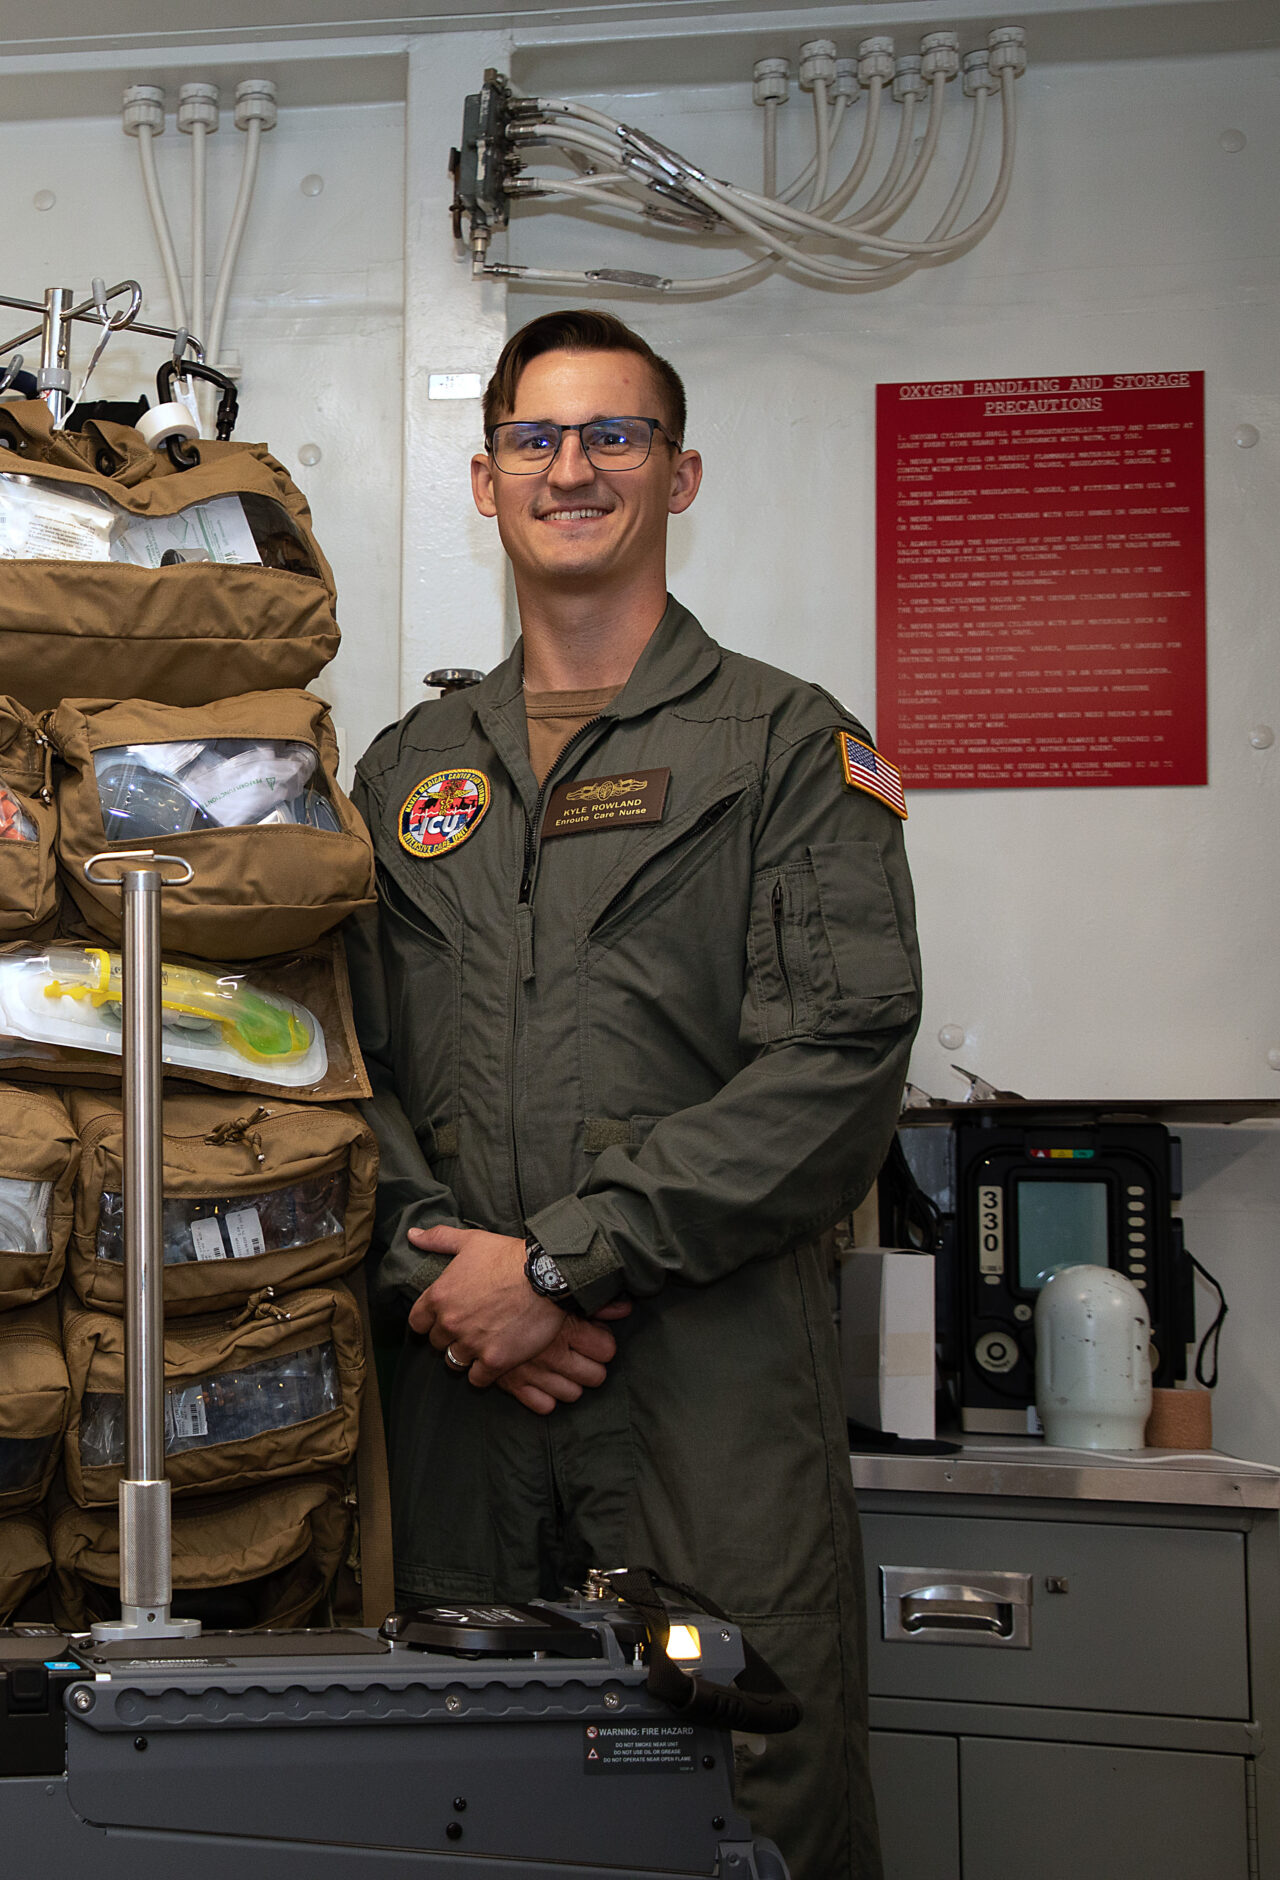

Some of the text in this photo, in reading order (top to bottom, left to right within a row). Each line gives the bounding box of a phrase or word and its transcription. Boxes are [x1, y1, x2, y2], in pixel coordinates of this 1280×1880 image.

[899, 373, 1190, 398] OXYGEN HANDLING AND STORAGE
[985, 397, 1102, 414] PRECAUTIONS
[405, 794, 420, 813] NAVAL
[419, 775, 446, 794] MEDICAL
[555, 807, 647, 826] Enroute Care Nurse
[563, 798, 642, 816] KYLE ROWLAND
[419, 814, 460, 835] ICU
[403, 826, 468, 852] INTENSIVE CARE UNIT
[599, 1728, 640, 1736] WARNING:
[661, 1727, 694, 1735] HAZARD
